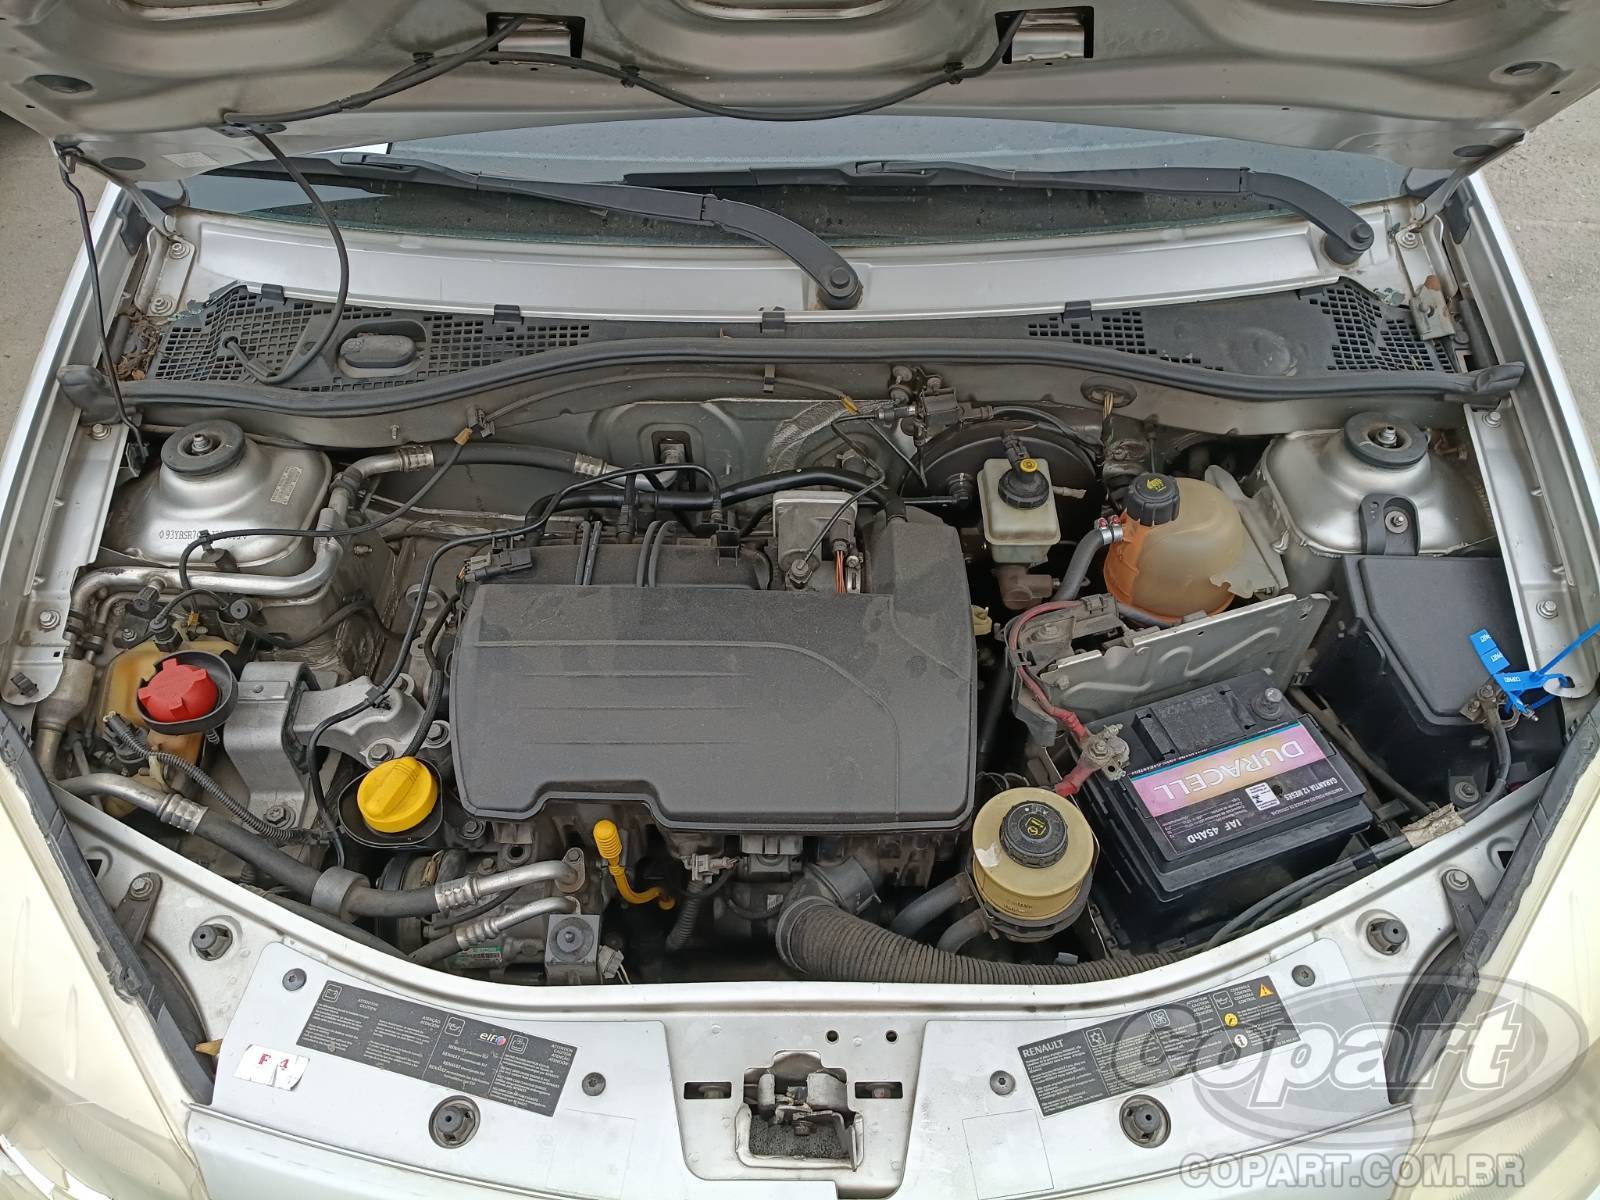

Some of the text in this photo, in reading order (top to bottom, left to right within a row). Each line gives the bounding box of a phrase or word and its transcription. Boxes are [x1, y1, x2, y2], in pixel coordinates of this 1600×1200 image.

[1154, 740, 1304, 800] DURACELL
[1283, 777, 1337, 800] GARANTIA 12 MESES
[479, 1032, 498, 1042] elf
[1022, 1039, 1064, 1058] RENAULT
[258, 1053, 271, 1065] F
